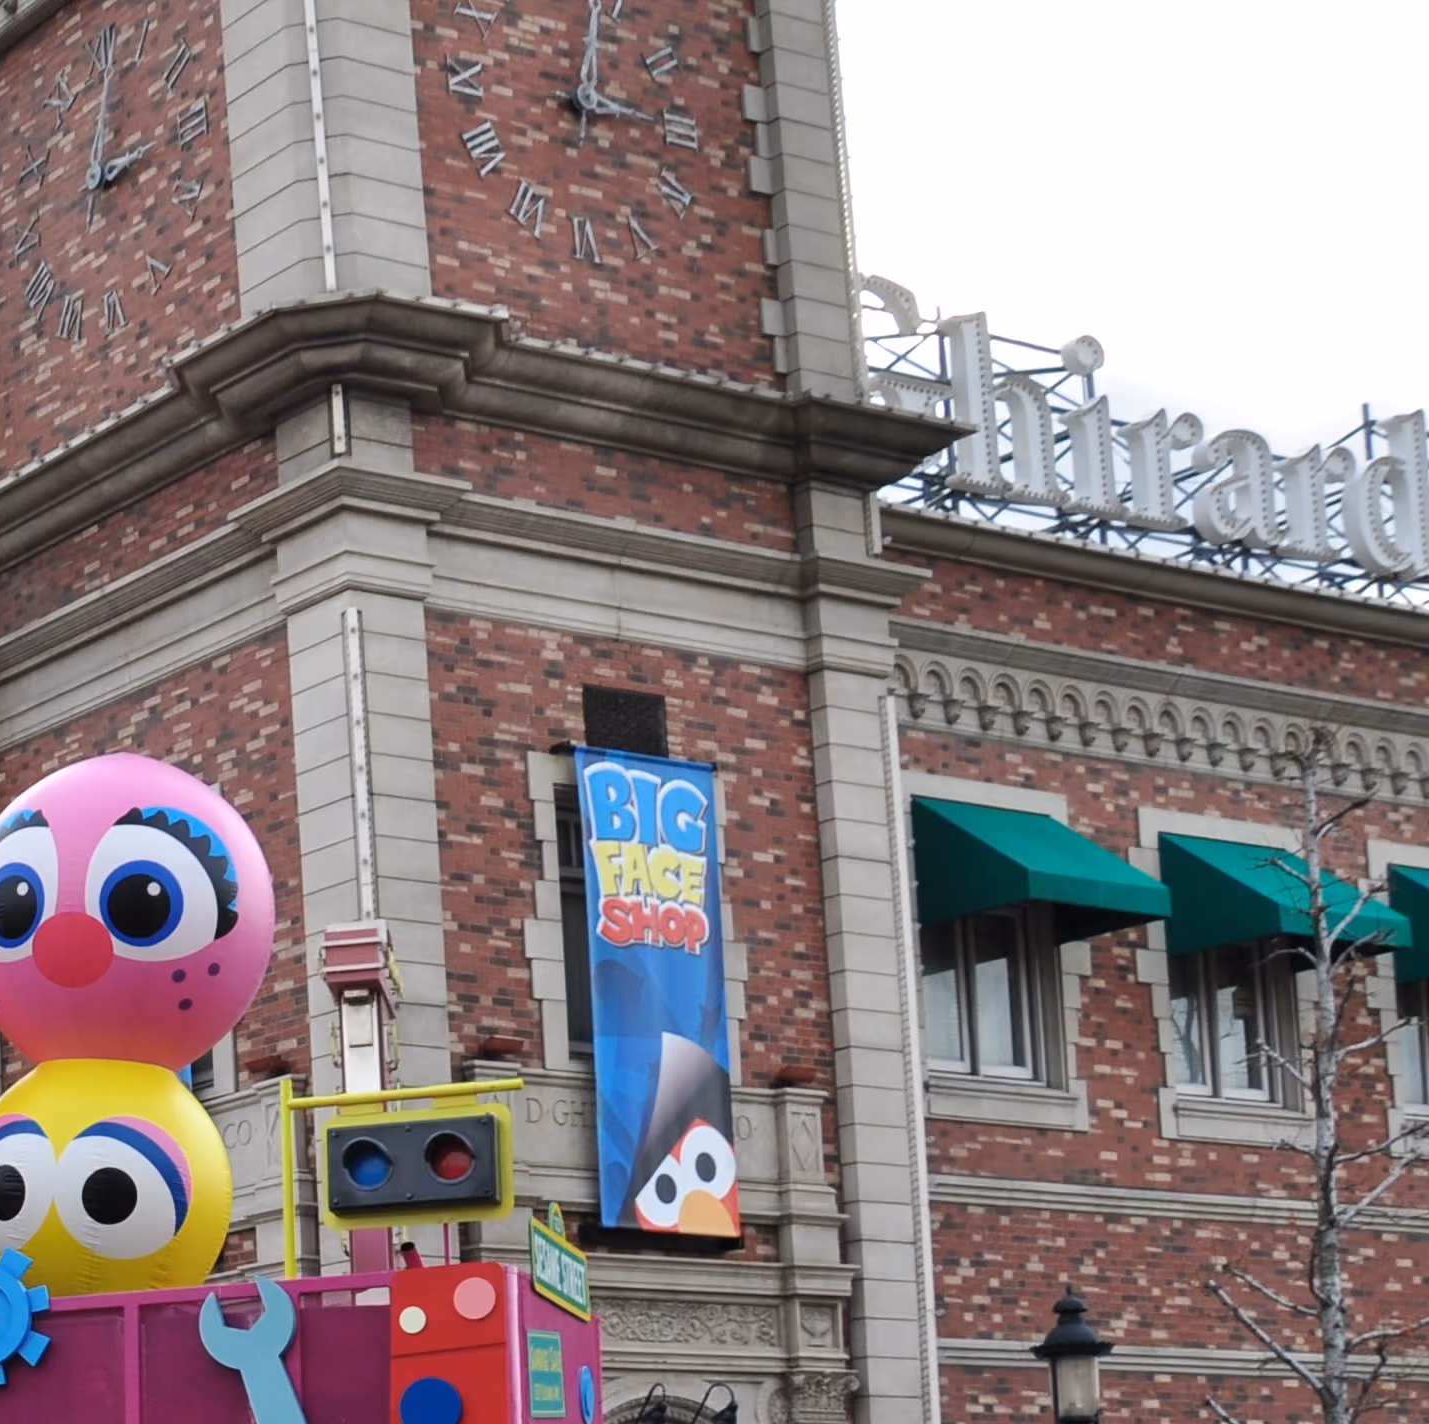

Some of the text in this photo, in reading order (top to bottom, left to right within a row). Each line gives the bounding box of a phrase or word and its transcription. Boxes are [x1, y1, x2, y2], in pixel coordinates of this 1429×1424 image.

[585, 764, 708, 852] BIG
[592, 840, 708, 905] FACE
[599, 896, 709, 954] SHOP
